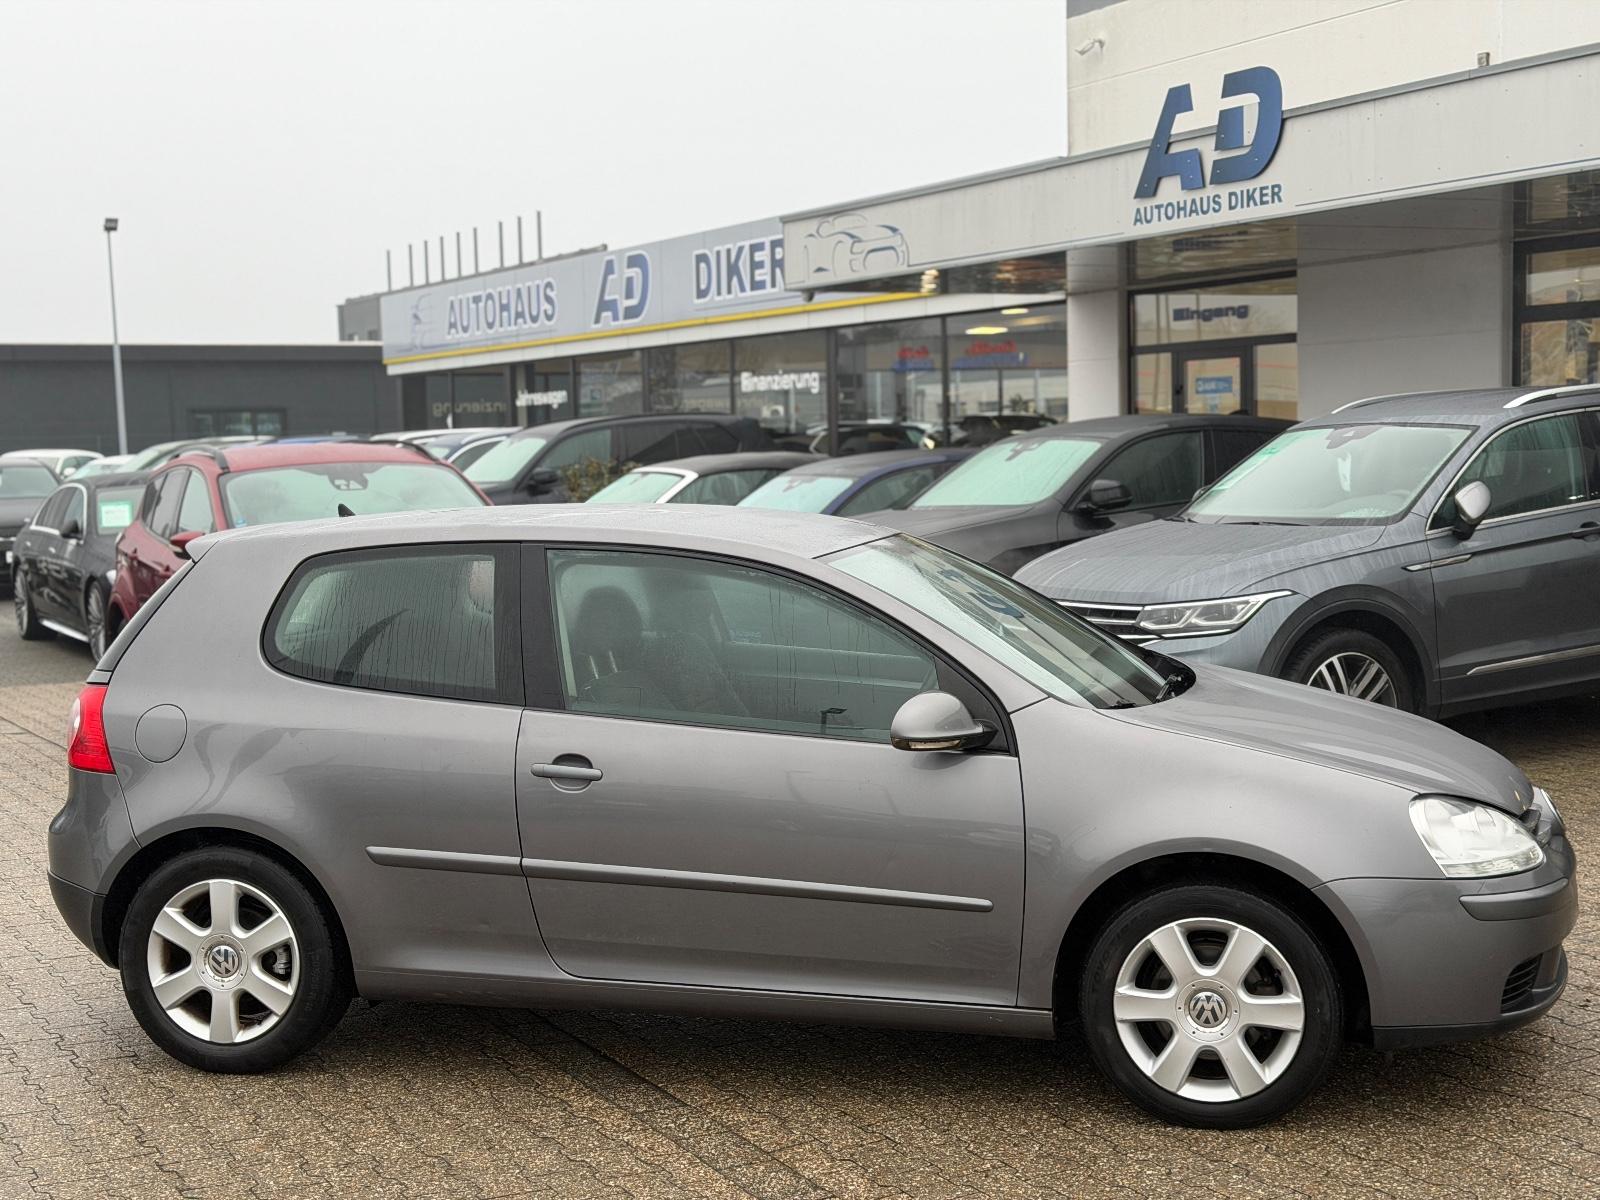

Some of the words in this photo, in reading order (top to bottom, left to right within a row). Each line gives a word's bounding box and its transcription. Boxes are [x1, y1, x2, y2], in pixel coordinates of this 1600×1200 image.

[1134, 66, 1282, 198] AD
[1133, 194, 1222, 226] AUTOHAUS
[1228, 184, 1282, 211] DIKER
[447, 280, 556, 336] AUTOHAUS
[695, 235, 784, 300] DIKER
[740, 369, 820, 394] Finanzierung
